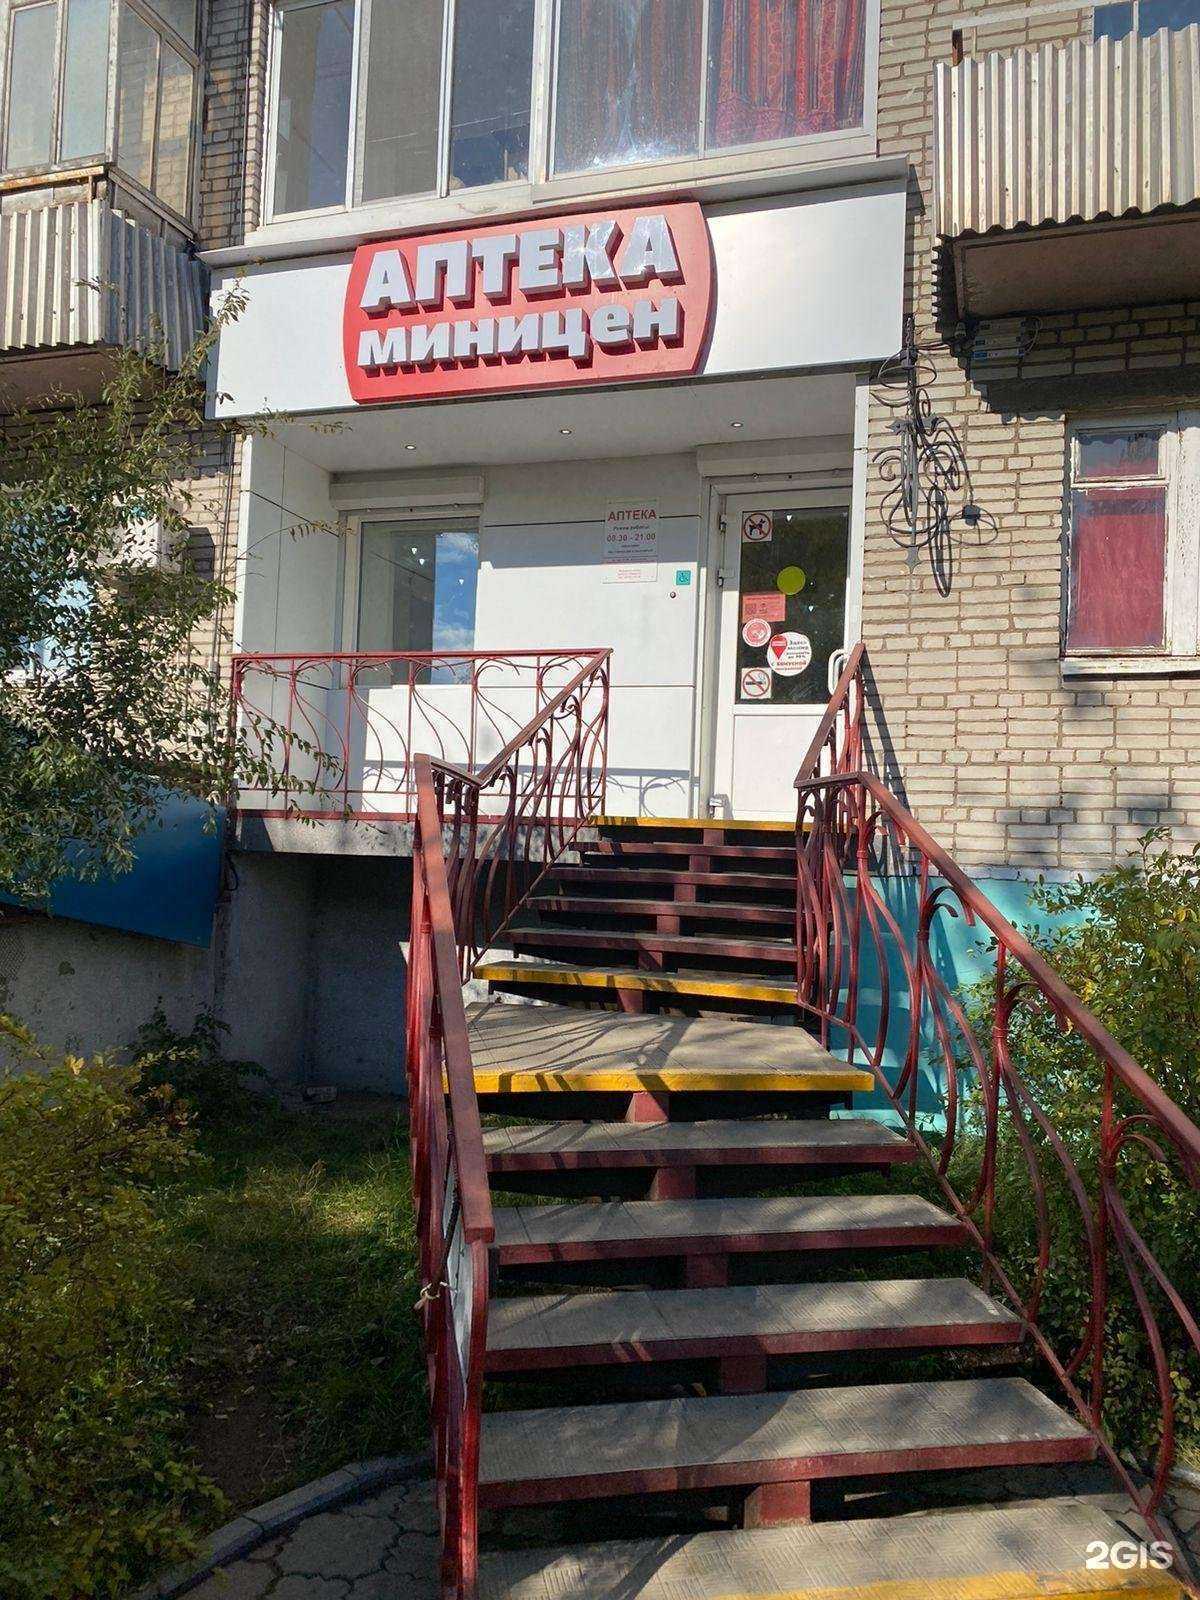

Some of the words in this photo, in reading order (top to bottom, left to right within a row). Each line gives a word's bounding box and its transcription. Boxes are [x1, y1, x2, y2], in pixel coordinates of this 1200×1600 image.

[360, 213, 682, 315] АПТЕКА
[357, 296, 682, 372] миницен
[608, 509, 657, 521] АПТЕКА
